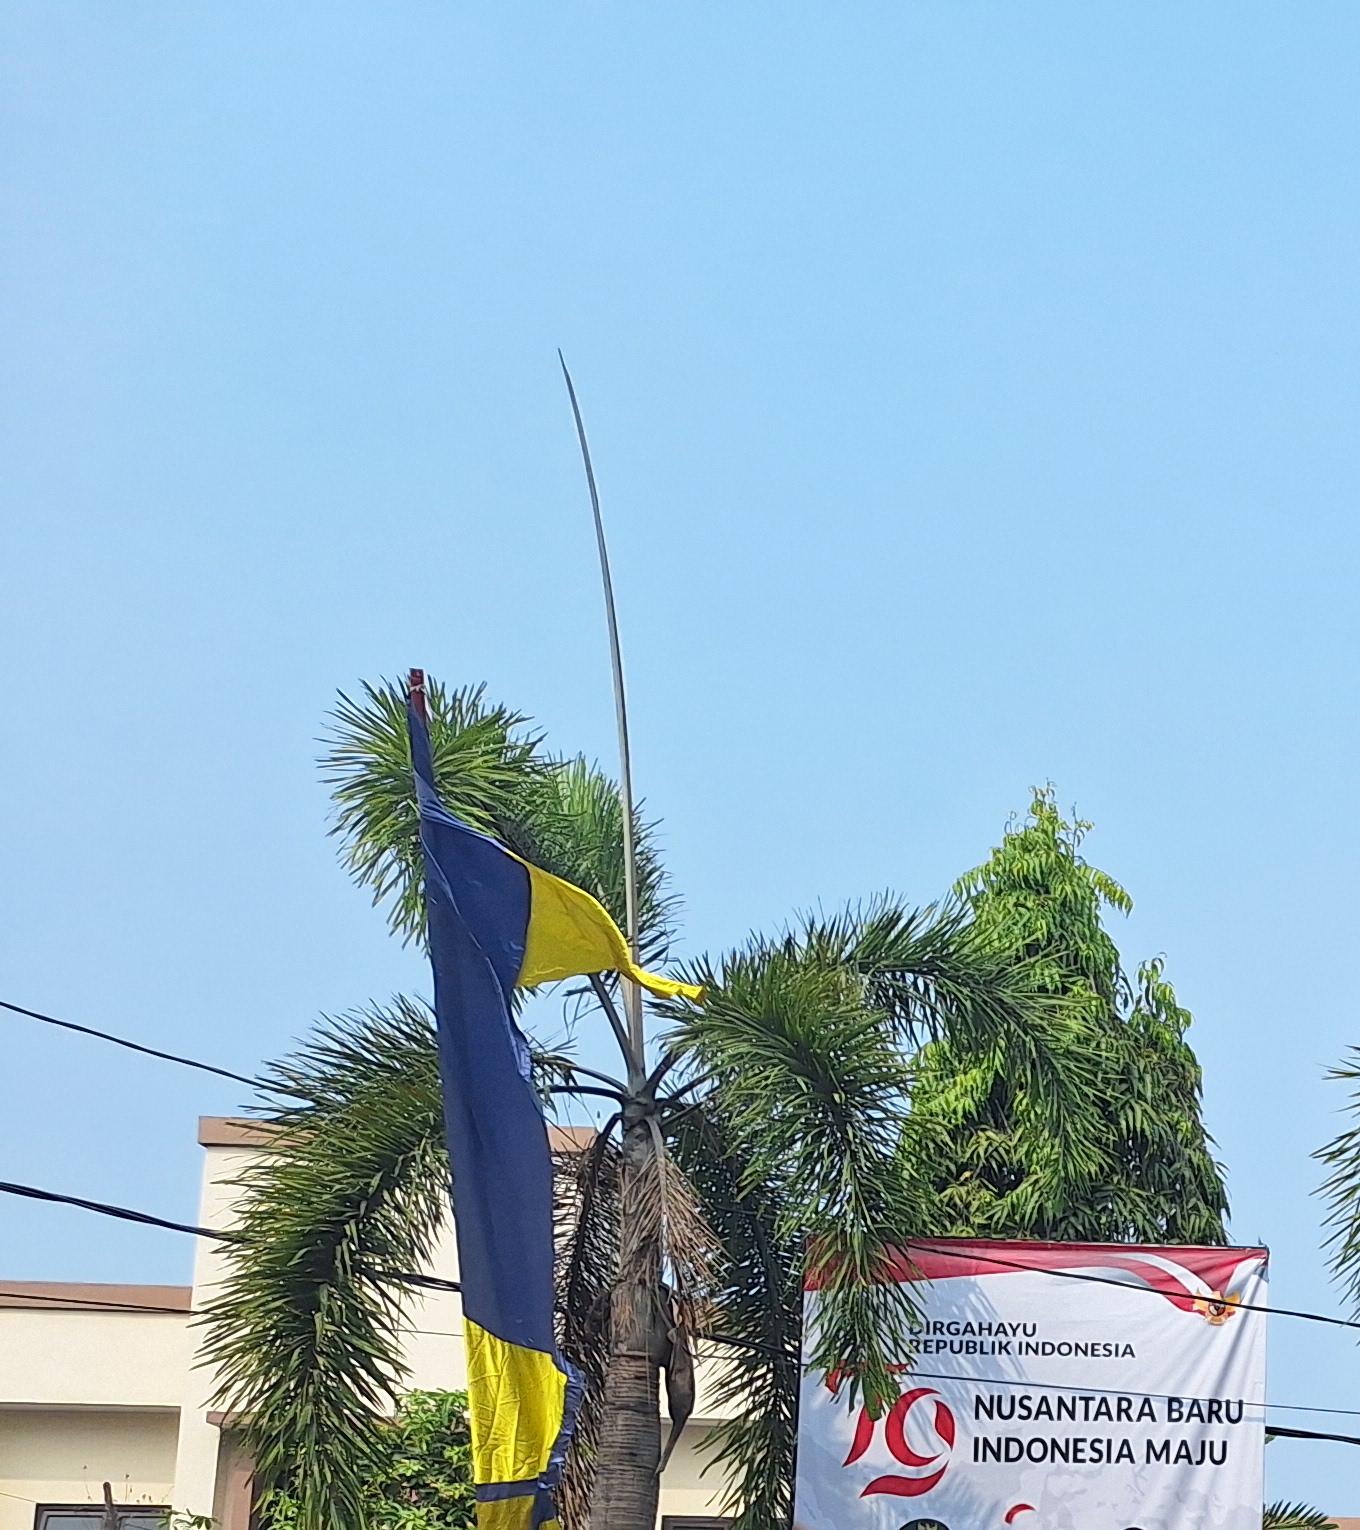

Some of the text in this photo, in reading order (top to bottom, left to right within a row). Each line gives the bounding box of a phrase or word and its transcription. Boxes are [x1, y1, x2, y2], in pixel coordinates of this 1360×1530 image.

[909, 1320, 1037, 1337] DIRGAHAYU
[909, 1338, 1136, 1359] REPUBLIK INDONESIA
[974, 1394, 1244, 1425] NUSANTARA BARU
[972, 1436, 1228, 1466] INDONESIA MAJU
